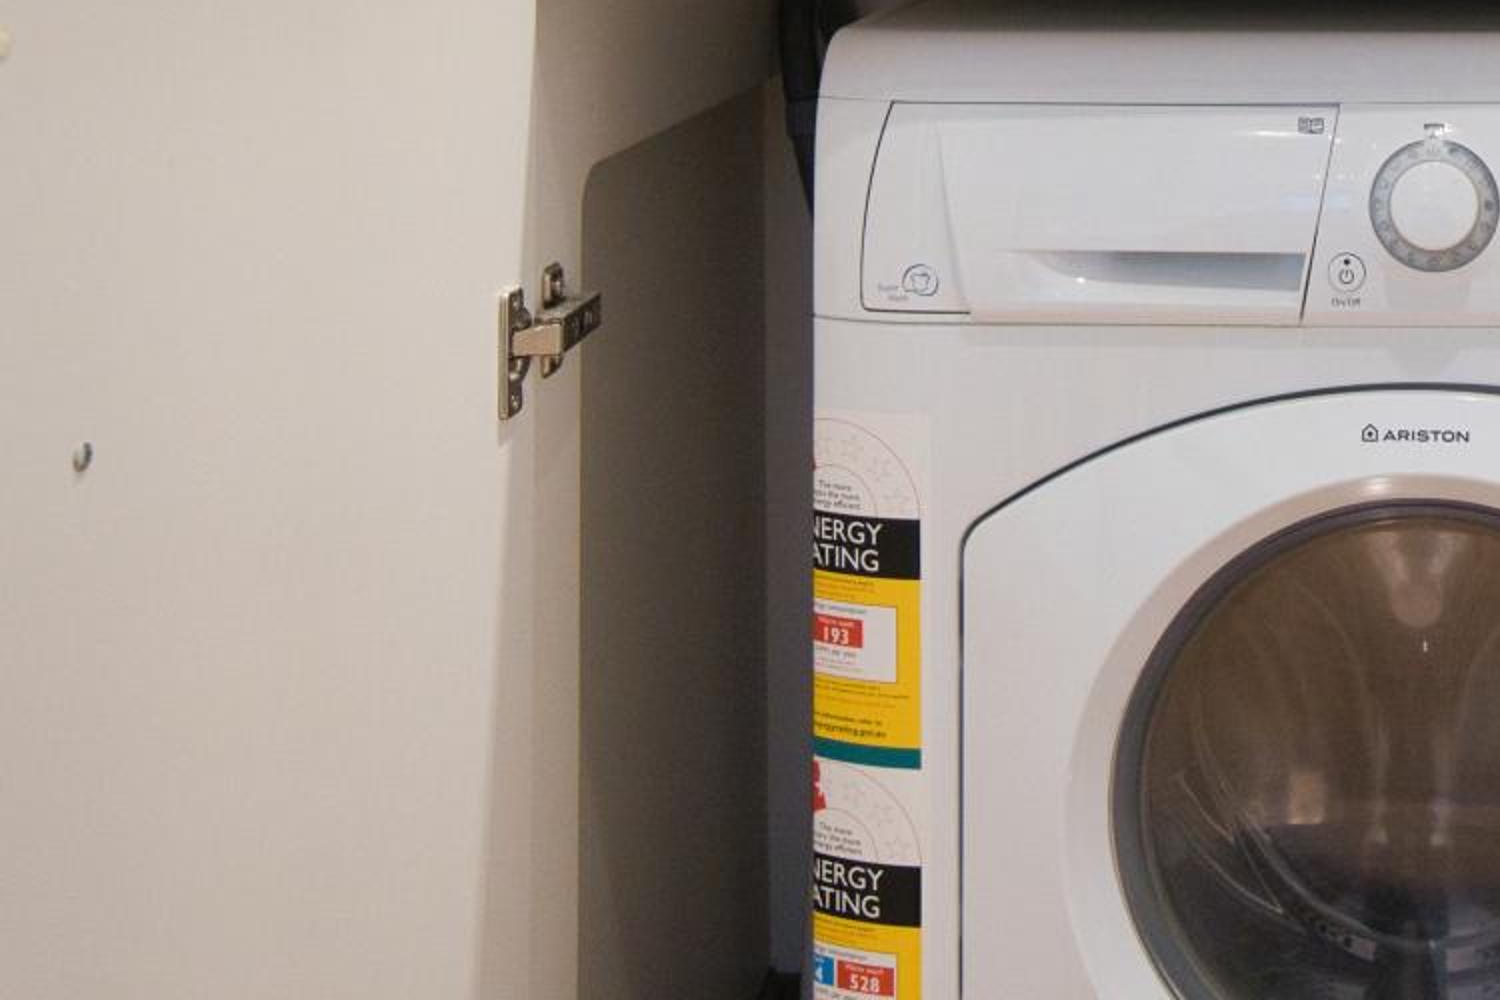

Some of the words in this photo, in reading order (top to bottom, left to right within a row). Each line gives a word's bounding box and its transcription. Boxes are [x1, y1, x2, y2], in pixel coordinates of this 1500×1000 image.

[1383, 429, 1470, 442] ARISTON
[823, 626, 850, 645] 193
[849, 972, 880, 994] 528
